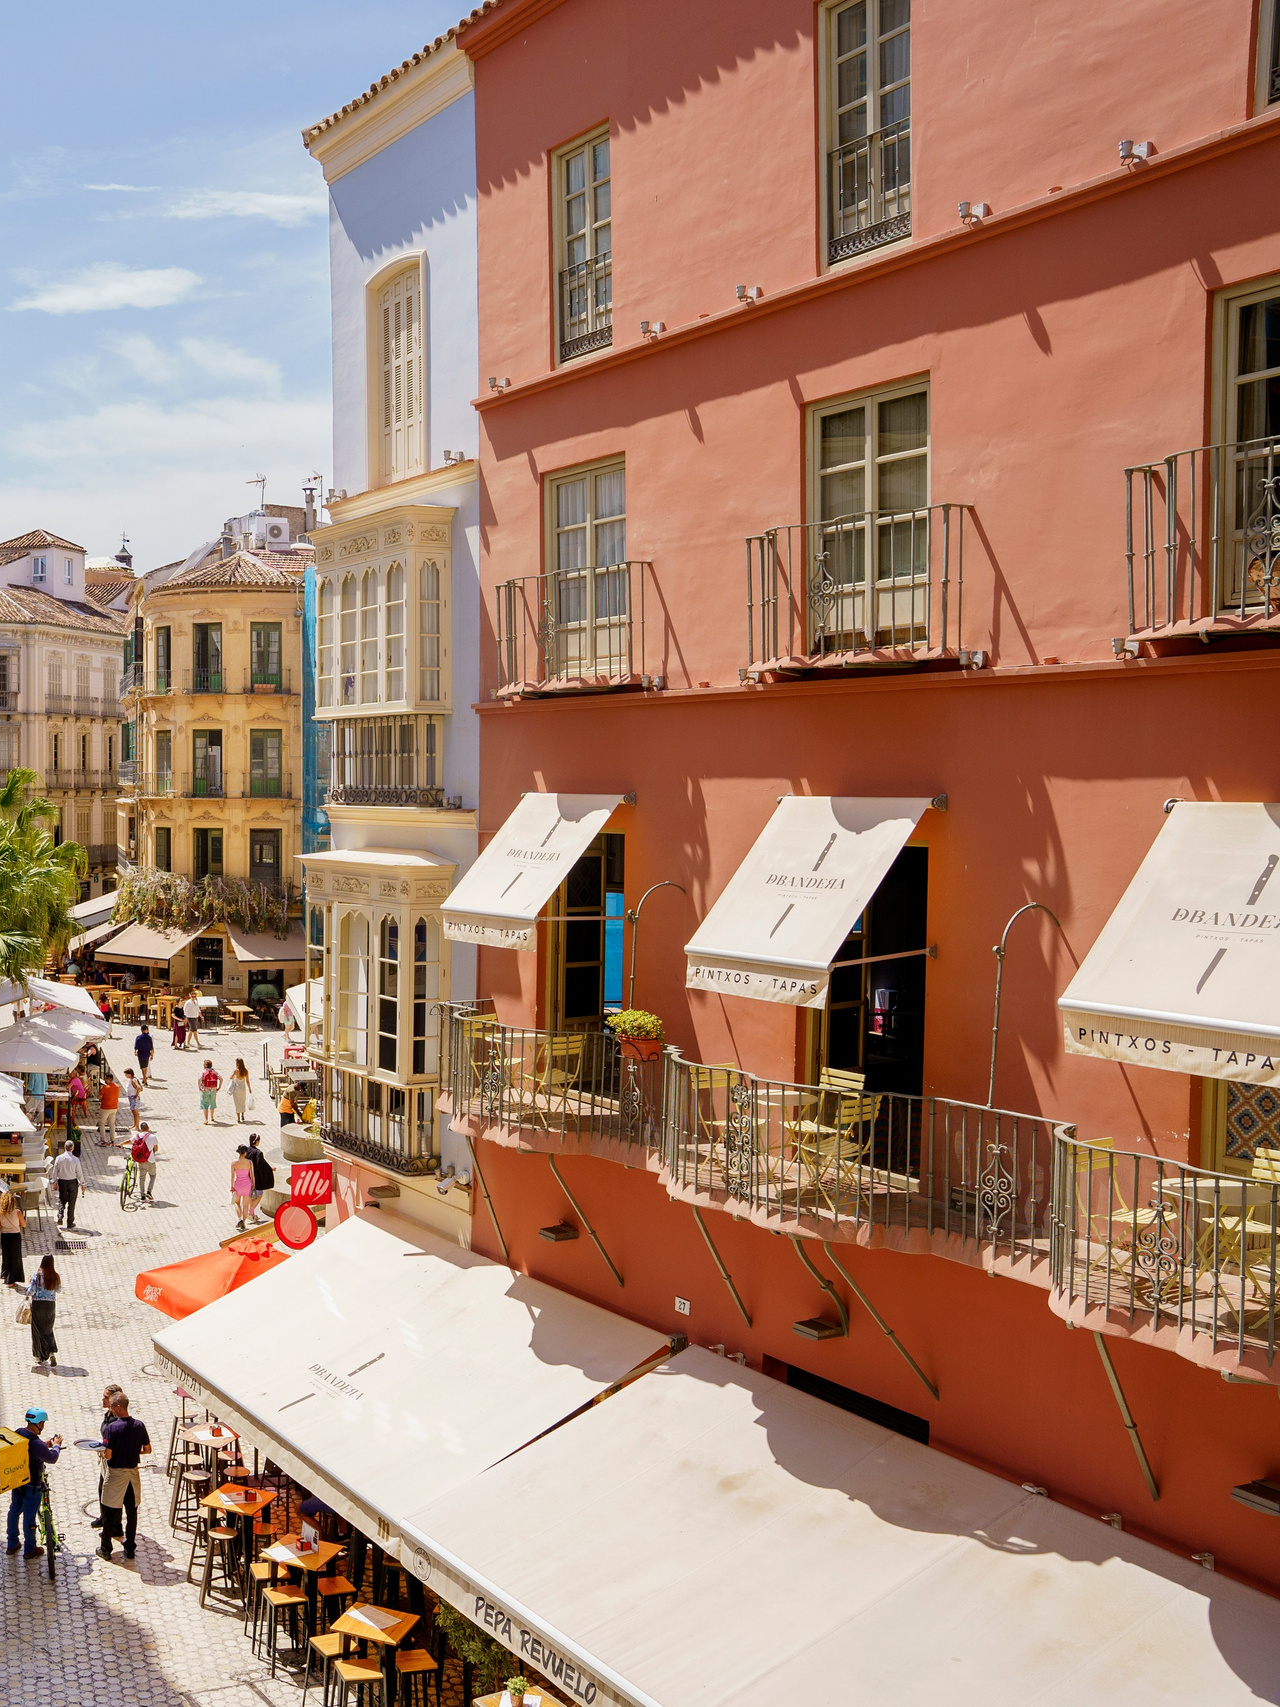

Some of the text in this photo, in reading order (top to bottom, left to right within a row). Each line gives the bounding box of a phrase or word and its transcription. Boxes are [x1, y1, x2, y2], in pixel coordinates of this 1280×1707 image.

[448, 921, 486, 935] PINTXOS
[500, 928, 528, 941] TAPAS
[695, 967, 750, 985] PINTXOS
[772, 978, 818, 995] TAPAS
[1078, 1027, 1172, 1054] PINTXOS
[293, 1169, 330, 1202] illy
[678, 1300, 686, 1311] 27
[3, 1463, 25, 1475] Glovo
[474, 1596, 597, 1705] PEPA REVUELO
